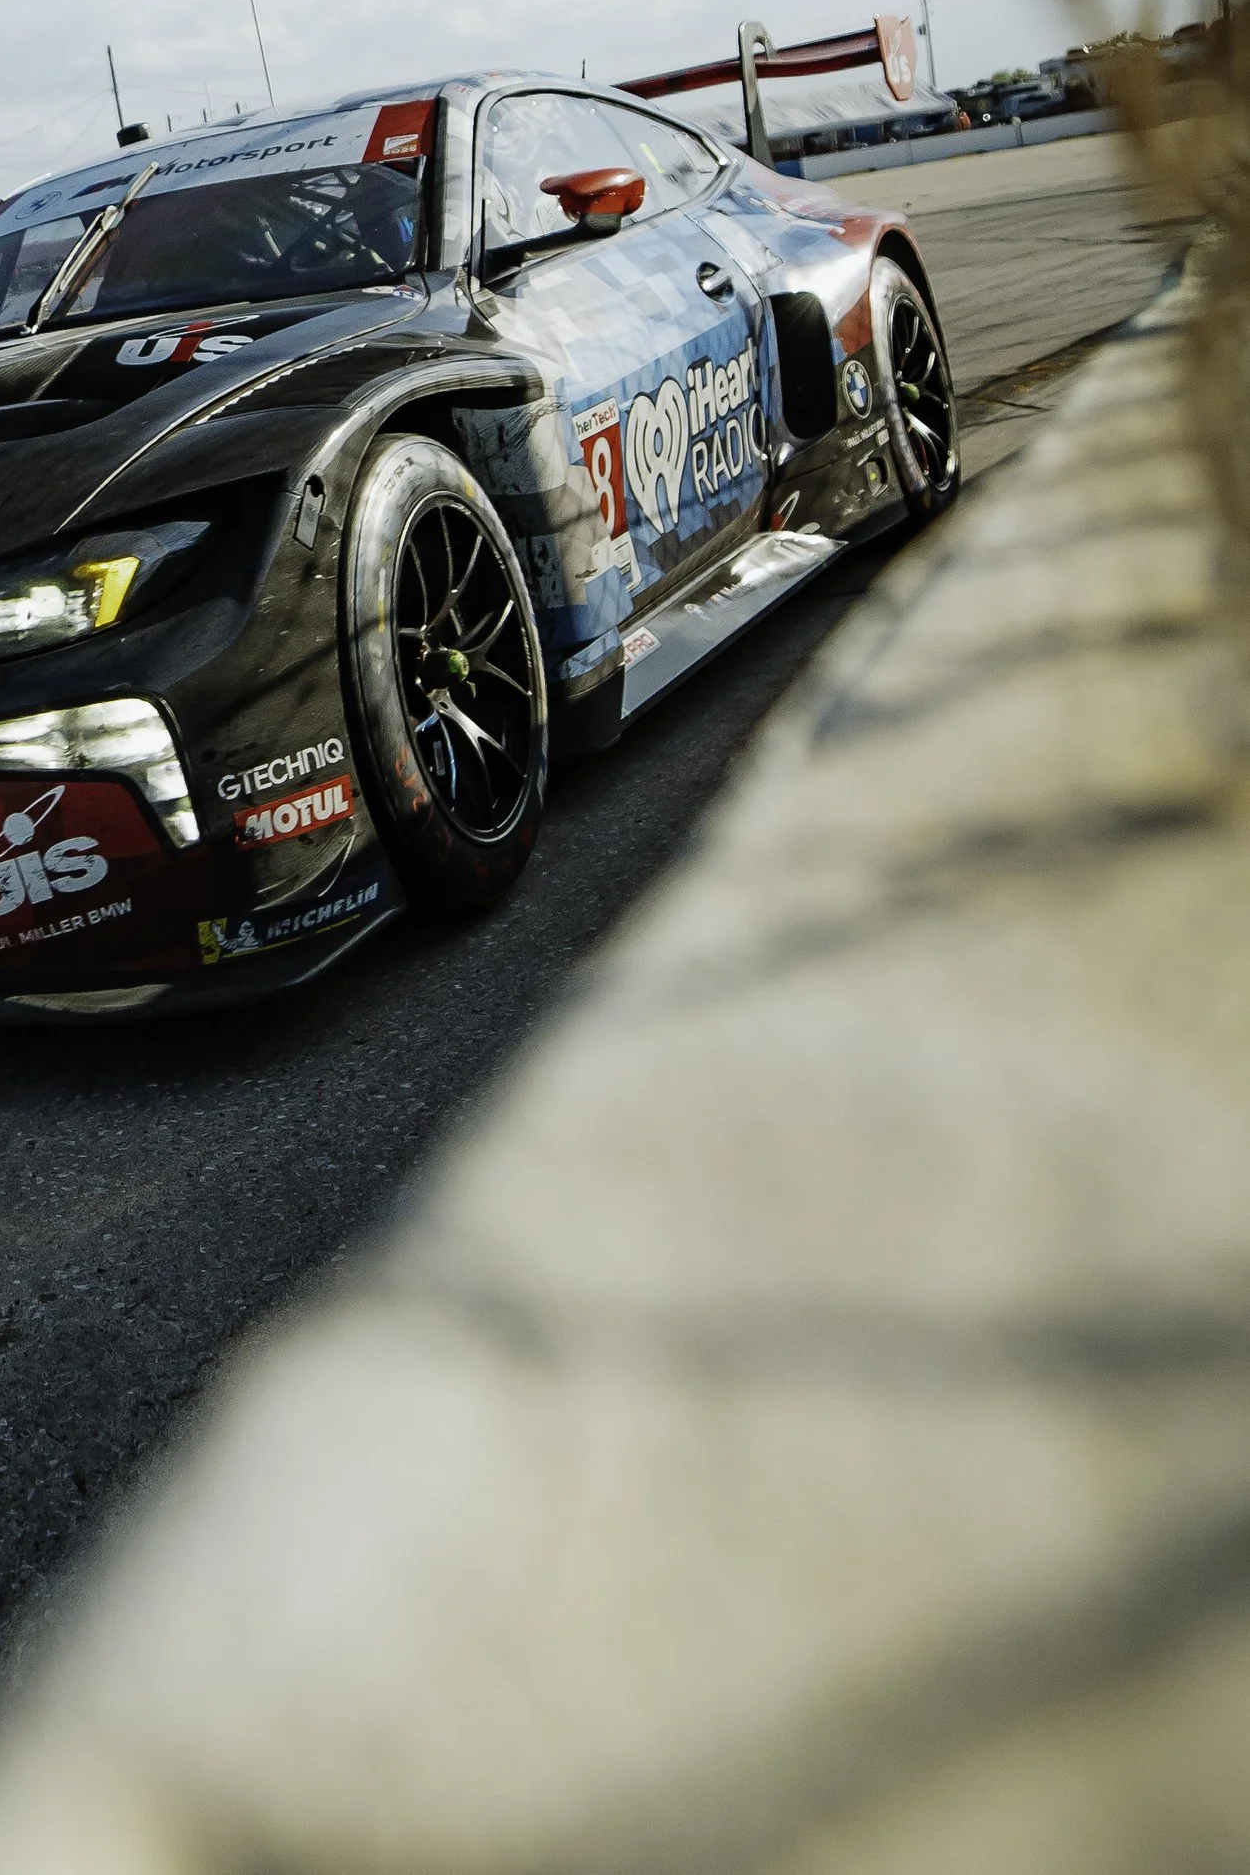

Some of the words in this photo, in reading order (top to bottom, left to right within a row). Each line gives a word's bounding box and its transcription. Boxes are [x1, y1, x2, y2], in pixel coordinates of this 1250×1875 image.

[156, 134, 339, 178] Motorsport
[116, 323, 254, 366] UIS
[686, 337, 759, 436] iHeart
[691, 403, 766, 502] RADIO
[626, 633, 655, 659] PRO
[217, 737, 345, 800] GTECHNIQ
[244, 784, 350, 841] MOTUL
[18, 914, 86, 944] MILLER
[87, 897, 133, 925] BMW
[266, 882, 379, 940] MICHELIN
